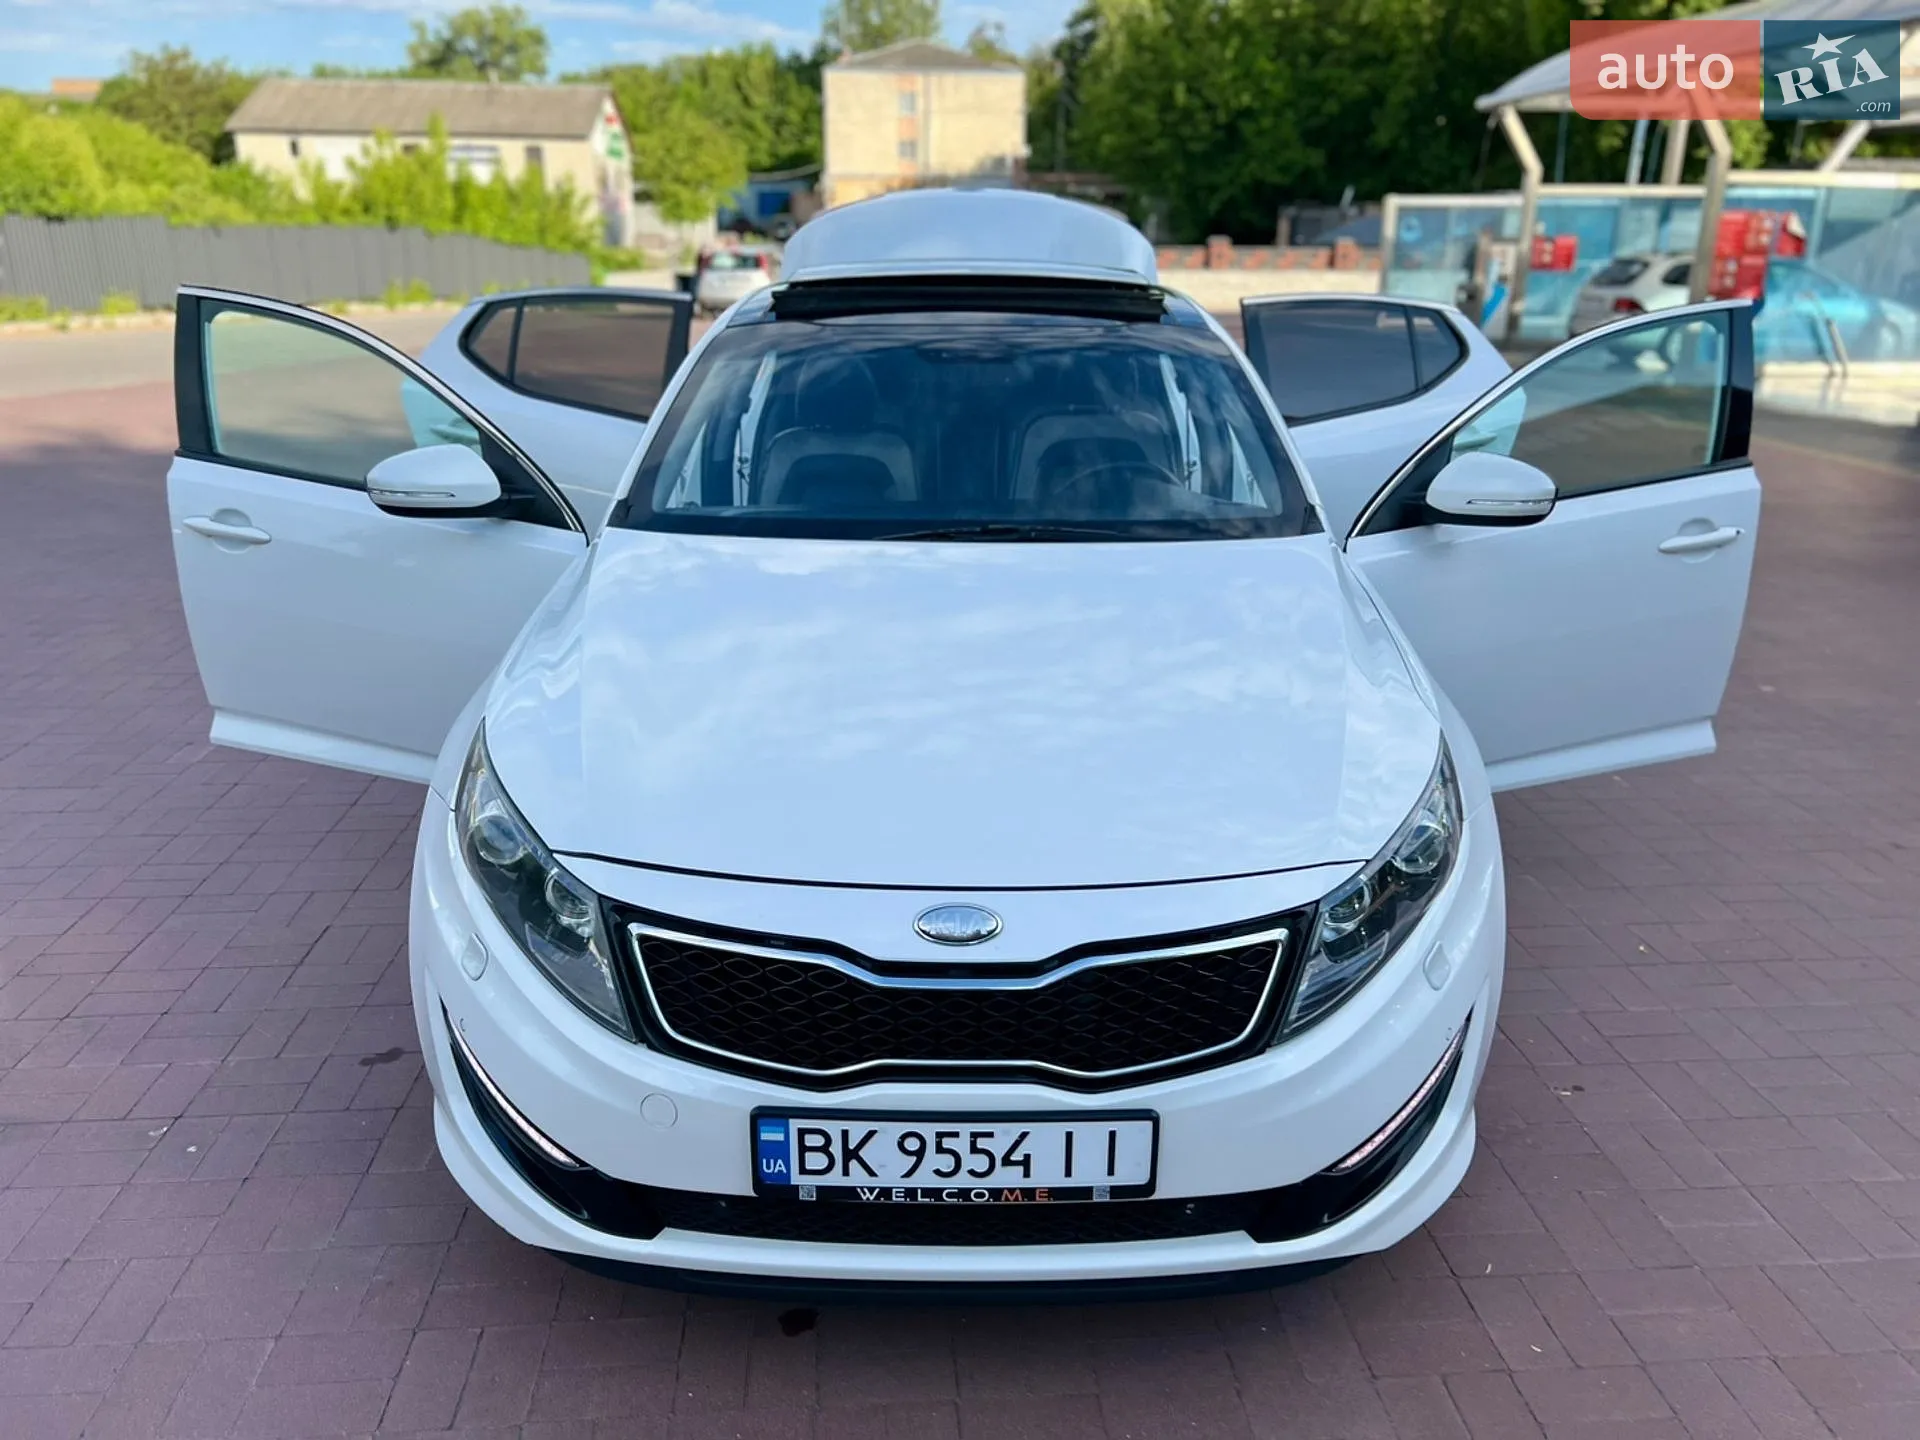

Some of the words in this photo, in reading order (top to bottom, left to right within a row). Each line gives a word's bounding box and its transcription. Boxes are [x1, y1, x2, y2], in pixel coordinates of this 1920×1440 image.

[762, 1158, 787, 1174] UA
[797, 1126, 879, 1178] BK
[897, 1130, 1032, 1179] 9554
